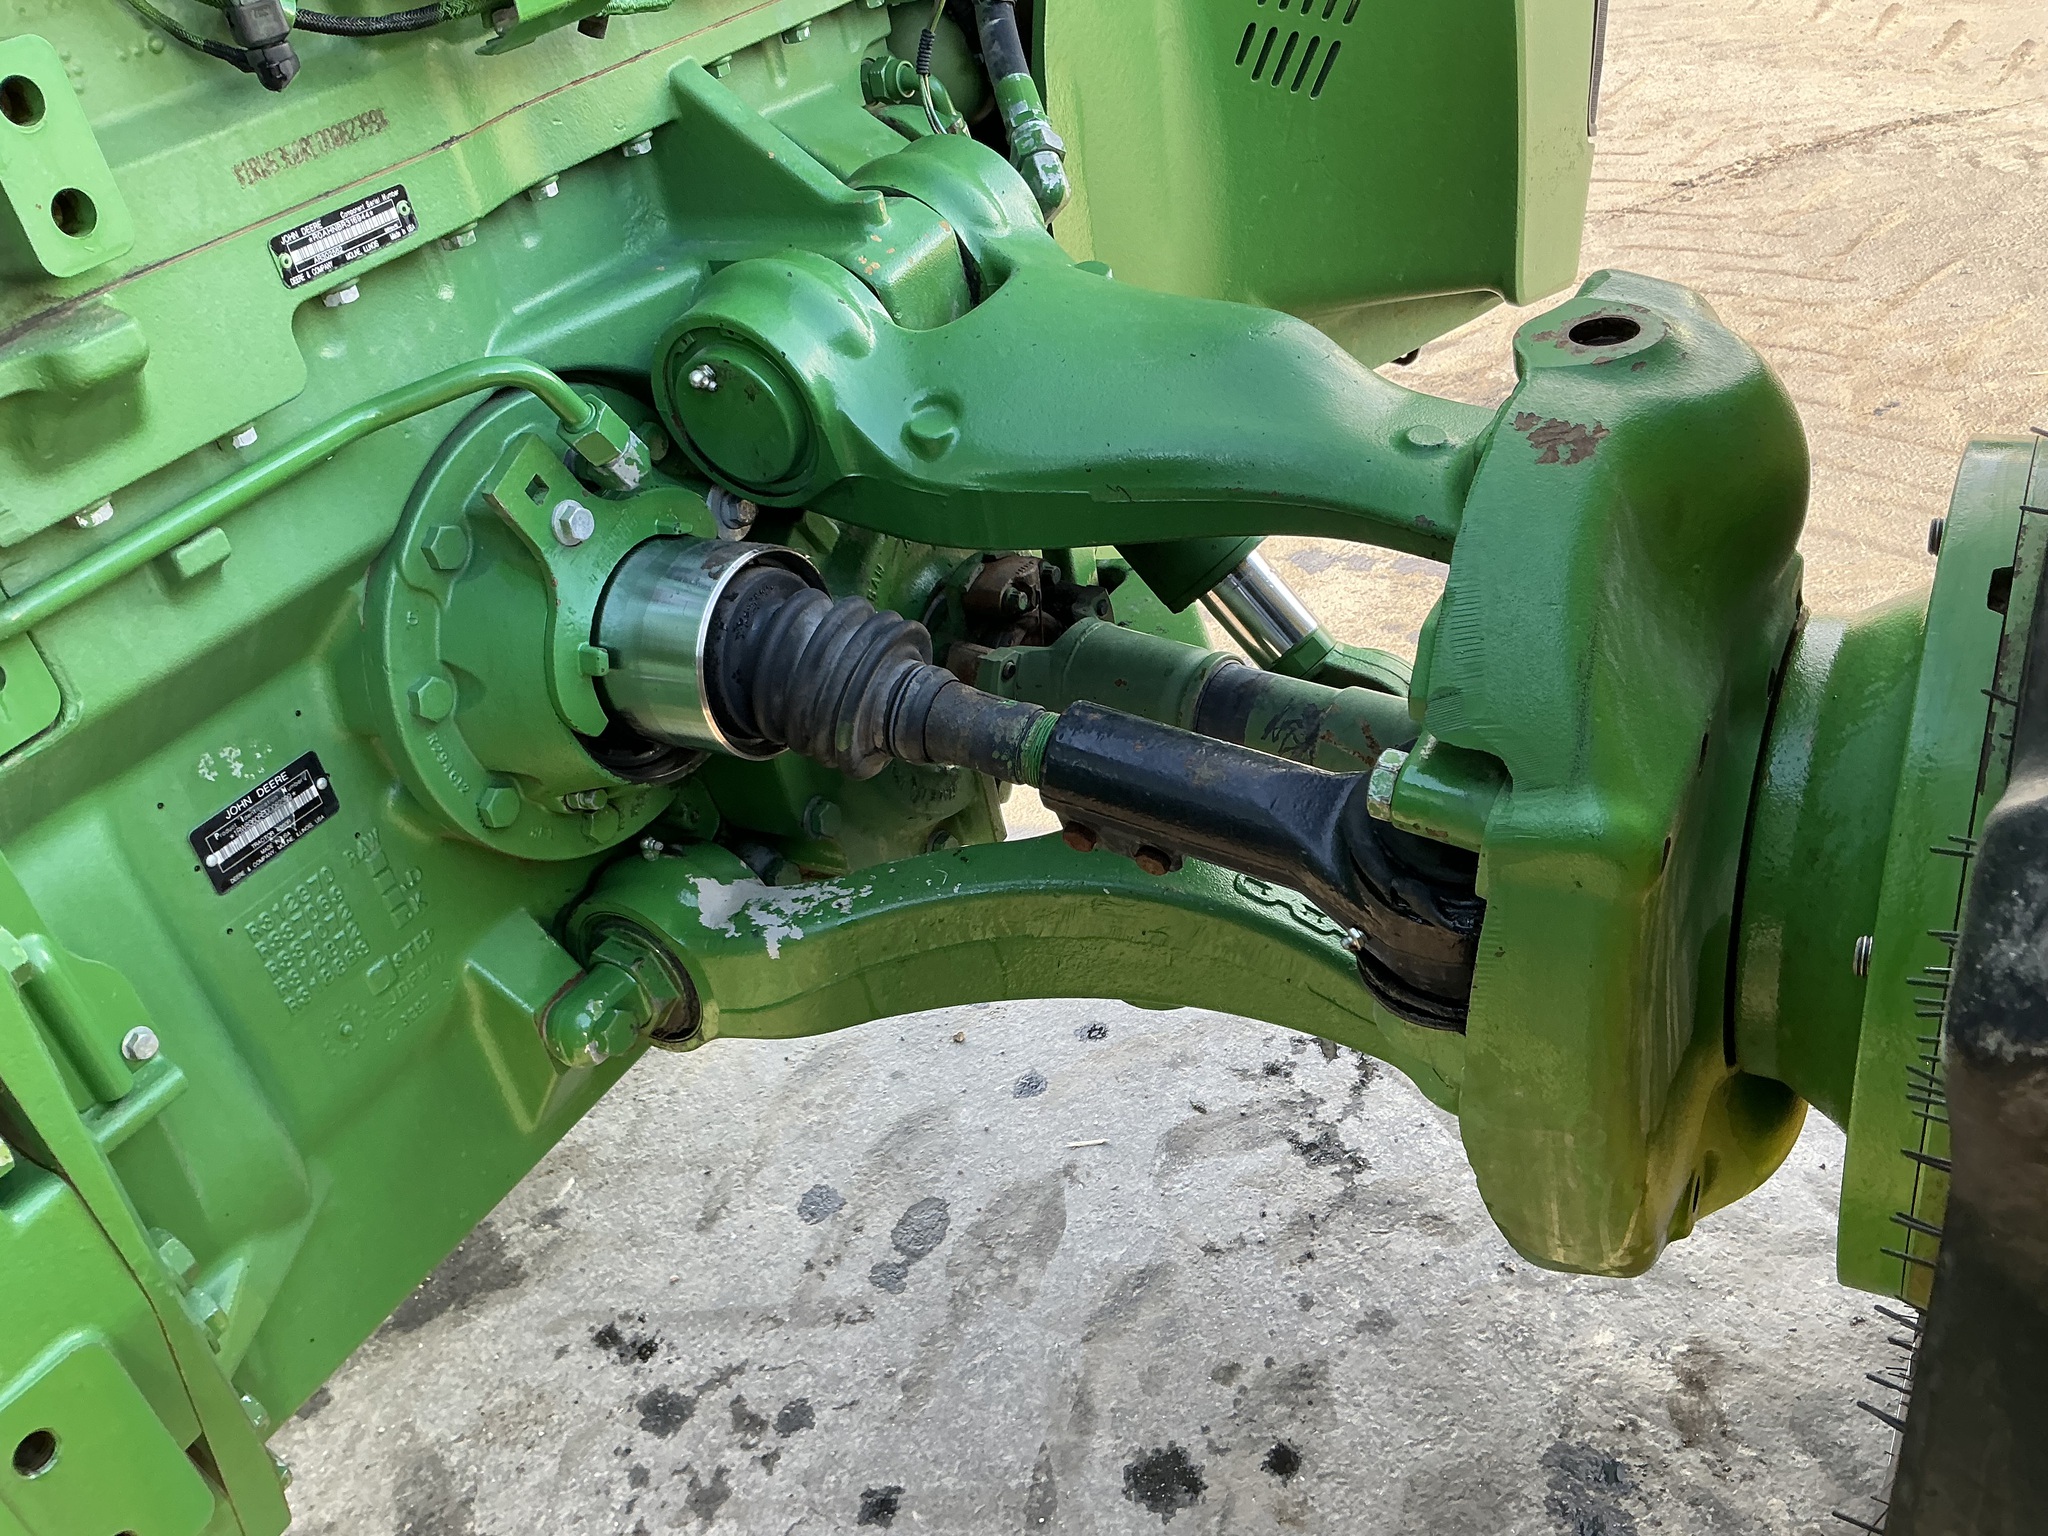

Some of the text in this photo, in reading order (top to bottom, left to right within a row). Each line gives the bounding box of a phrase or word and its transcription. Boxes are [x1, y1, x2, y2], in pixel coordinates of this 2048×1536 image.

[280, 189, 399, 245] JOHN DEERE Component Serial Number
[290, 275, 306, 286] DEERE
[311, 262, 334, 276] COMPANY
[213, 822, 237, 840] Product
[280, 778, 303, 794] Number
[225, 771, 288, 819] JOHN DEERE
[229, 869, 246, 884] DEERE
[313, 814, 324, 824] USA
[250, 830, 275, 848] TRACTOR
[259, 843, 273, 854] MADE
